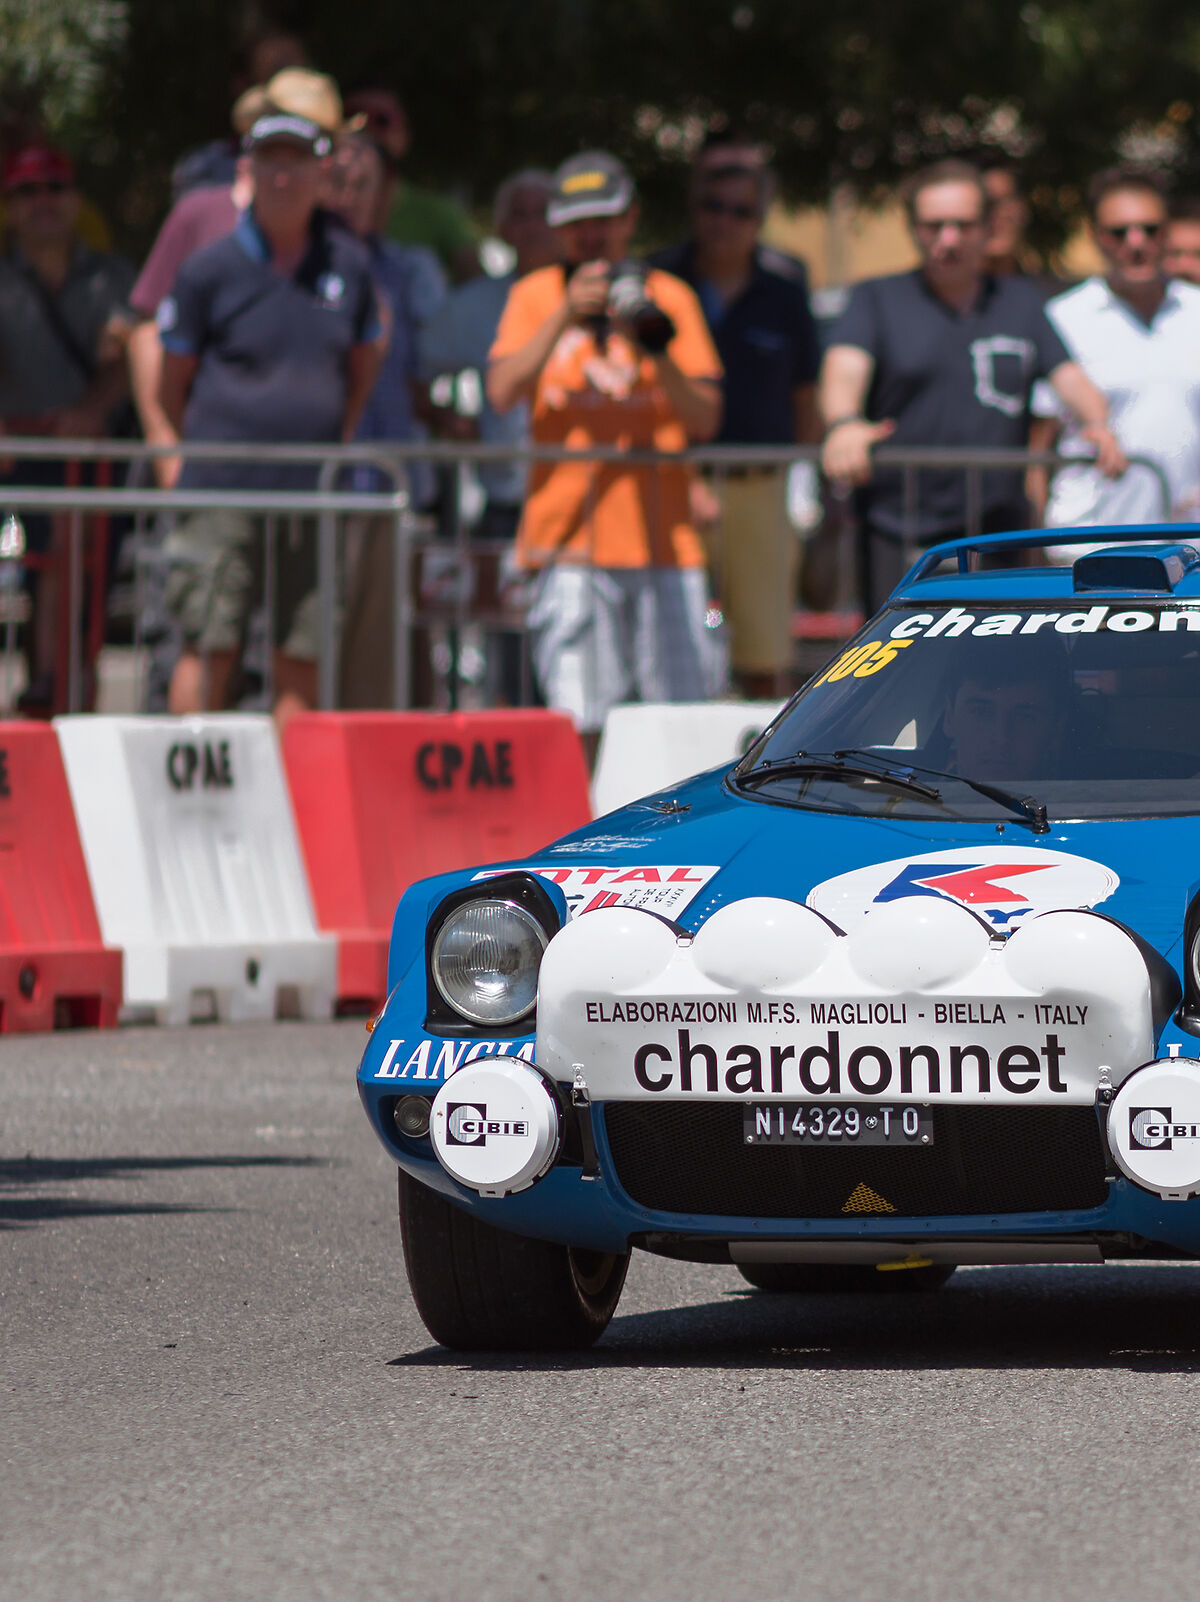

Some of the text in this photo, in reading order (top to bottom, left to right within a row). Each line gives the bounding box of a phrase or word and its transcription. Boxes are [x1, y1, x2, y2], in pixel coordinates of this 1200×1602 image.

[813, 639, 914, 688] 105
[166, 742, 235, 790] CPAE
[415, 741, 515, 790] CPAE
[586, 1002, 737, 1023] ELABORAZIONI
[746, 1002, 800, 1024] M.F.S.
[810, 1003, 906, 1024] MAGLIOLI
[935, 1003, 1006, 1024] BIELLA
[1034, 1004, 1088, 1025] ITALY
[634, 1029, 1068, 1095] chardonnet
